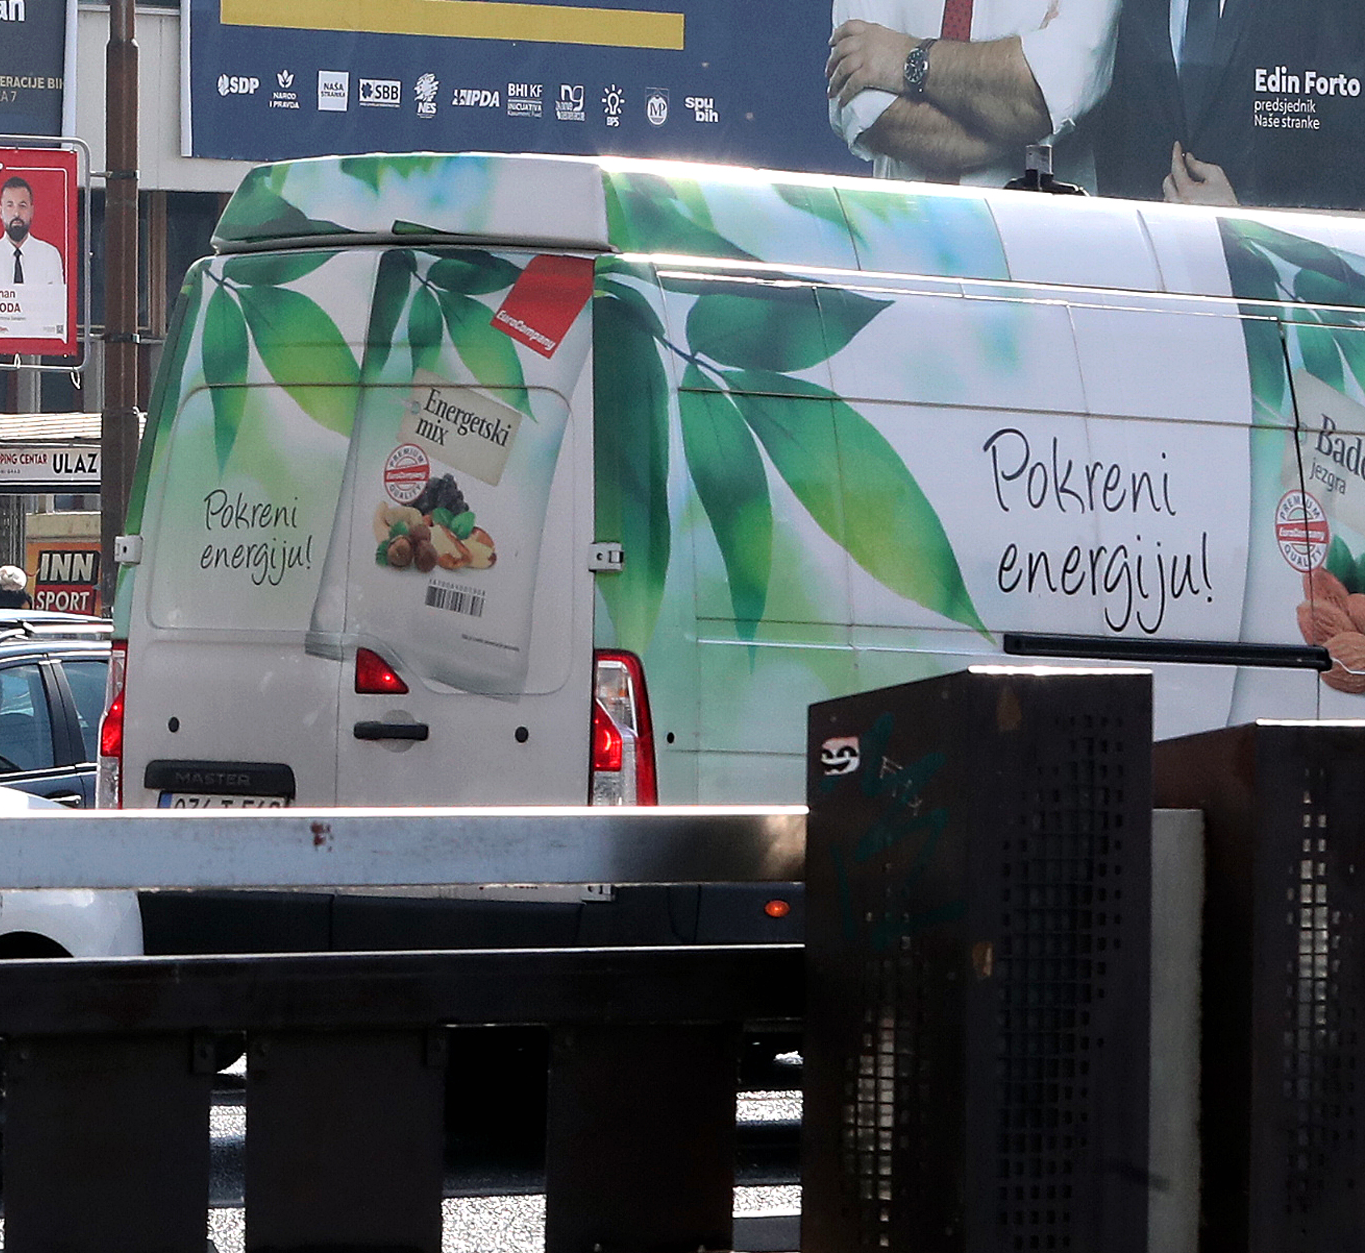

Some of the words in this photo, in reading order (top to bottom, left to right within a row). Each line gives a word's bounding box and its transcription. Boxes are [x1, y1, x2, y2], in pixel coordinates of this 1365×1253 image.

[230, 77, 260, 94] SDP
[323, 81, 344, 91] NAŠA
[508, 83, 528, 97] BHI
[530, 85, 543, 97] KF
[1255, 66, 1300, 94] Edin
[1305, 71, 1361, 97] Forto
[11, 90, 18, 102] 7
[374, 85, 399, 100] SBB
[417, 102, 437, 114] NES
[685, 97, 714, 109] spu
[1254, 97, 1316, 115] predsjednik
[695, 108, 719, 122] bih
[1254, 113, 1280, 128] Naše
[1281, 114, 1320, 129] stranke
[423, 387, 512, 448] Energetski
[415, 415, 448, 447] mix
[19, 453, 47, 465] CENTAR
[52, 453, 98, 474] ULAZ
[983, 428, 1177, 516] Pokreni
[1309, 457, 1347, 495] jezgra
[204, 489, 299, 531] Pokreni
[39, 553, 94, 582] INN
[200, 535, 313, 586] energiju!
[998, 532, 1213, 634] energiju!
[36, 591, 90, 611] SPORT
[175, 771, 251, 786] MASTER
